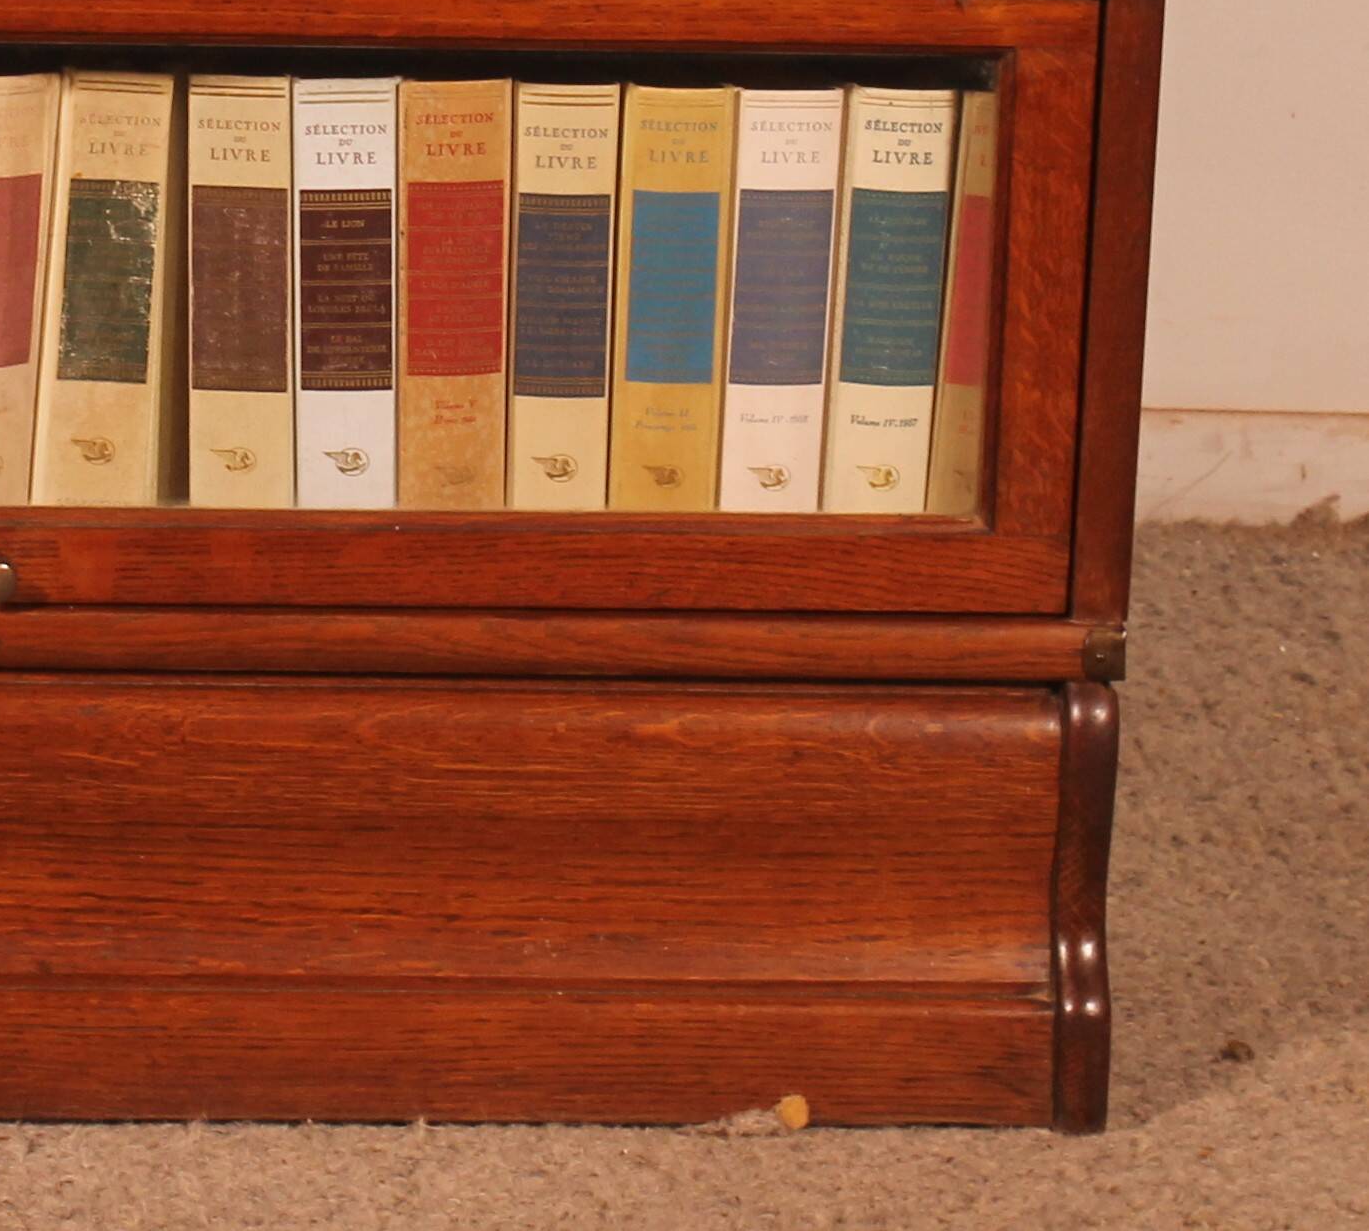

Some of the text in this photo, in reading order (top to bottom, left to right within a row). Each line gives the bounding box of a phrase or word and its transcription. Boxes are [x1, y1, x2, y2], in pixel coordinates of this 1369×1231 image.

[197, 118, 282, 132] SÉLECTION
[416, 112, 494, 125] SÉLECTION
[639, 119, 718, 132] SÉLECTION
[305, 122, 388, 136] SÉLECTION
[525, 125, 609, 140] SÉLECTION
[751, 120, 833, 133] SÉLECTION
[864, 119, 943, 134] SÉLECTION
[88, 141, 149, 156] LIVRE
[210, 147, 272, 163] LIVRE
[426, 142, 488, 157] LIVRE
[316, 152, 378, 166] LIVRE
[535, 155, 598, 171] LIVRE
[648, 150, 710, 164] LIVRE
[761, 151, 821, 165] LIVRE
[872, 150, 934, 166] LIVRE
